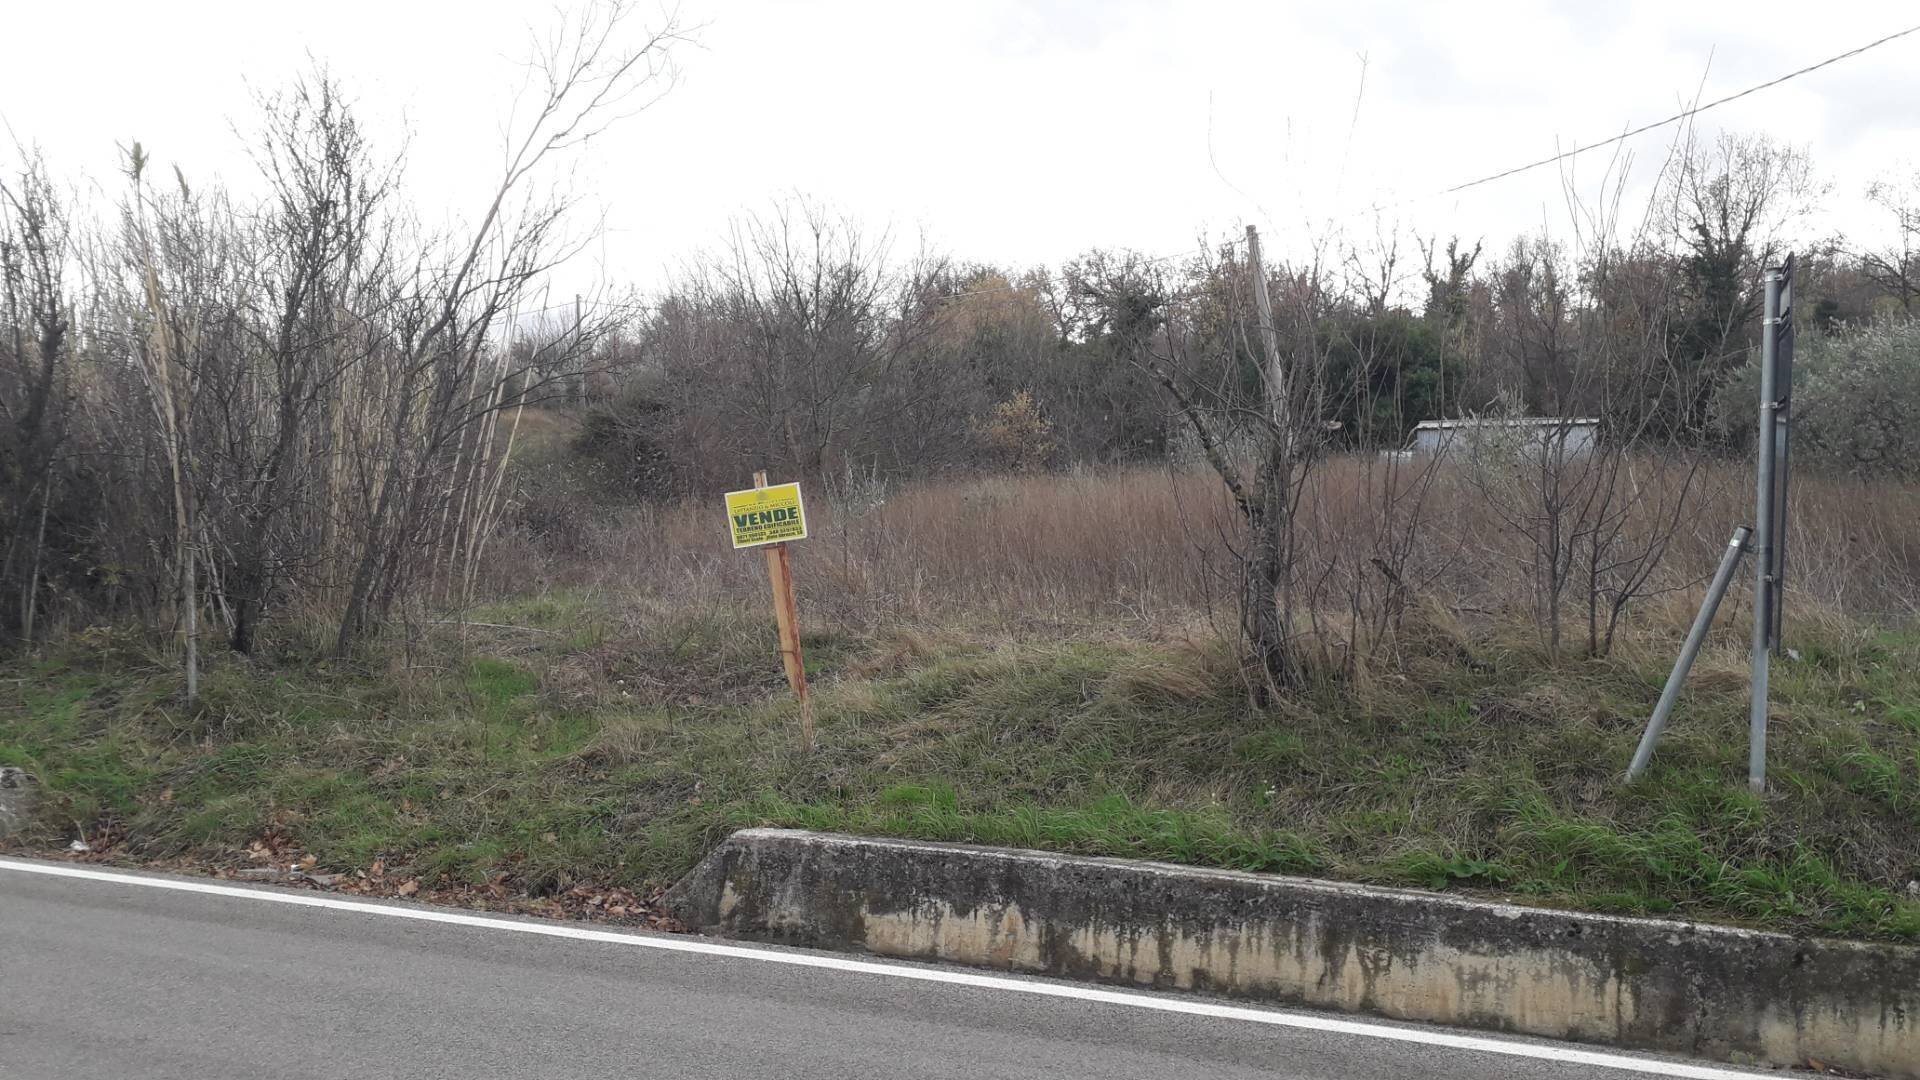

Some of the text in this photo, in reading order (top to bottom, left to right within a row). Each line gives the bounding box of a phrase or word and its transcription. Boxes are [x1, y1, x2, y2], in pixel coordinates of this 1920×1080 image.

[733, 507, 799, 527] VENDE
[736, 524, 763, 533] TERRENO
[764, 519, 800, 530] EDIFICABILE
